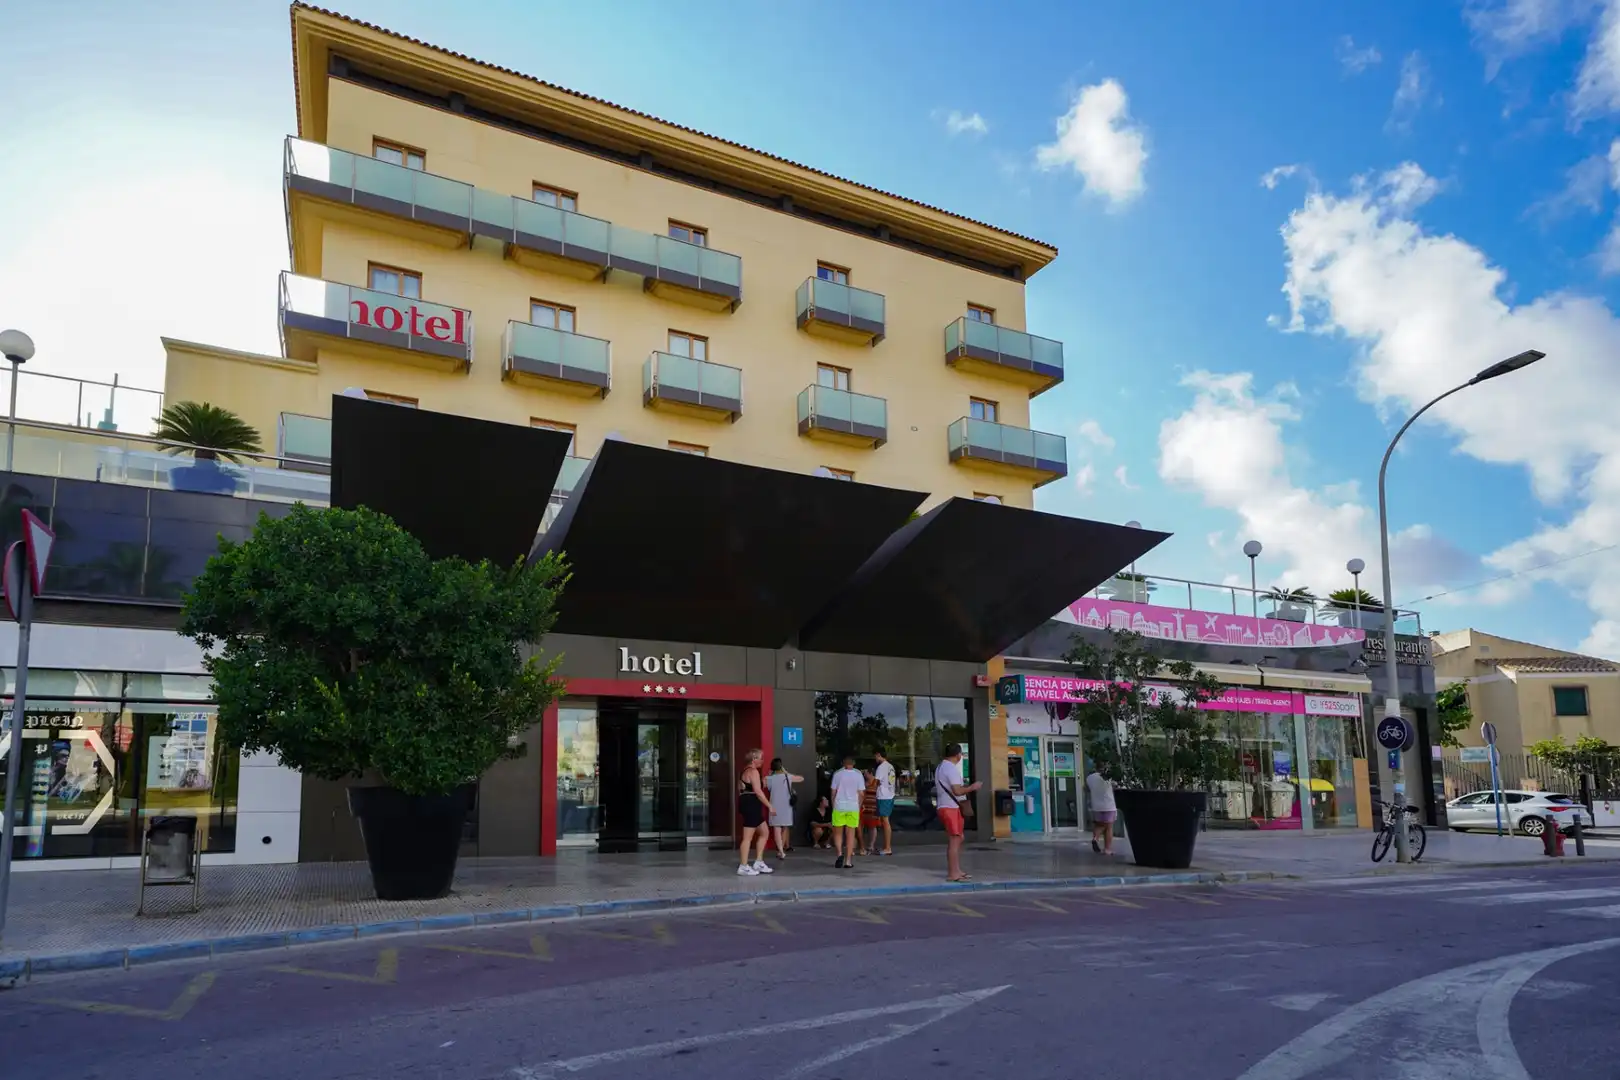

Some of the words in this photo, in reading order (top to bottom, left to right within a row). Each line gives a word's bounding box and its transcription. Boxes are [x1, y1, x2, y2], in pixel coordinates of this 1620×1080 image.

[1366, 637, 1428, 655] resturante
[619, 647, 703, 676] hotel
[1060, 681, 1073, 690] DE
[1025, 689, 1060, 699] TRAVEL
[26, 714, 84, 729] PLEIN
[788, 731, 797, 741] H
